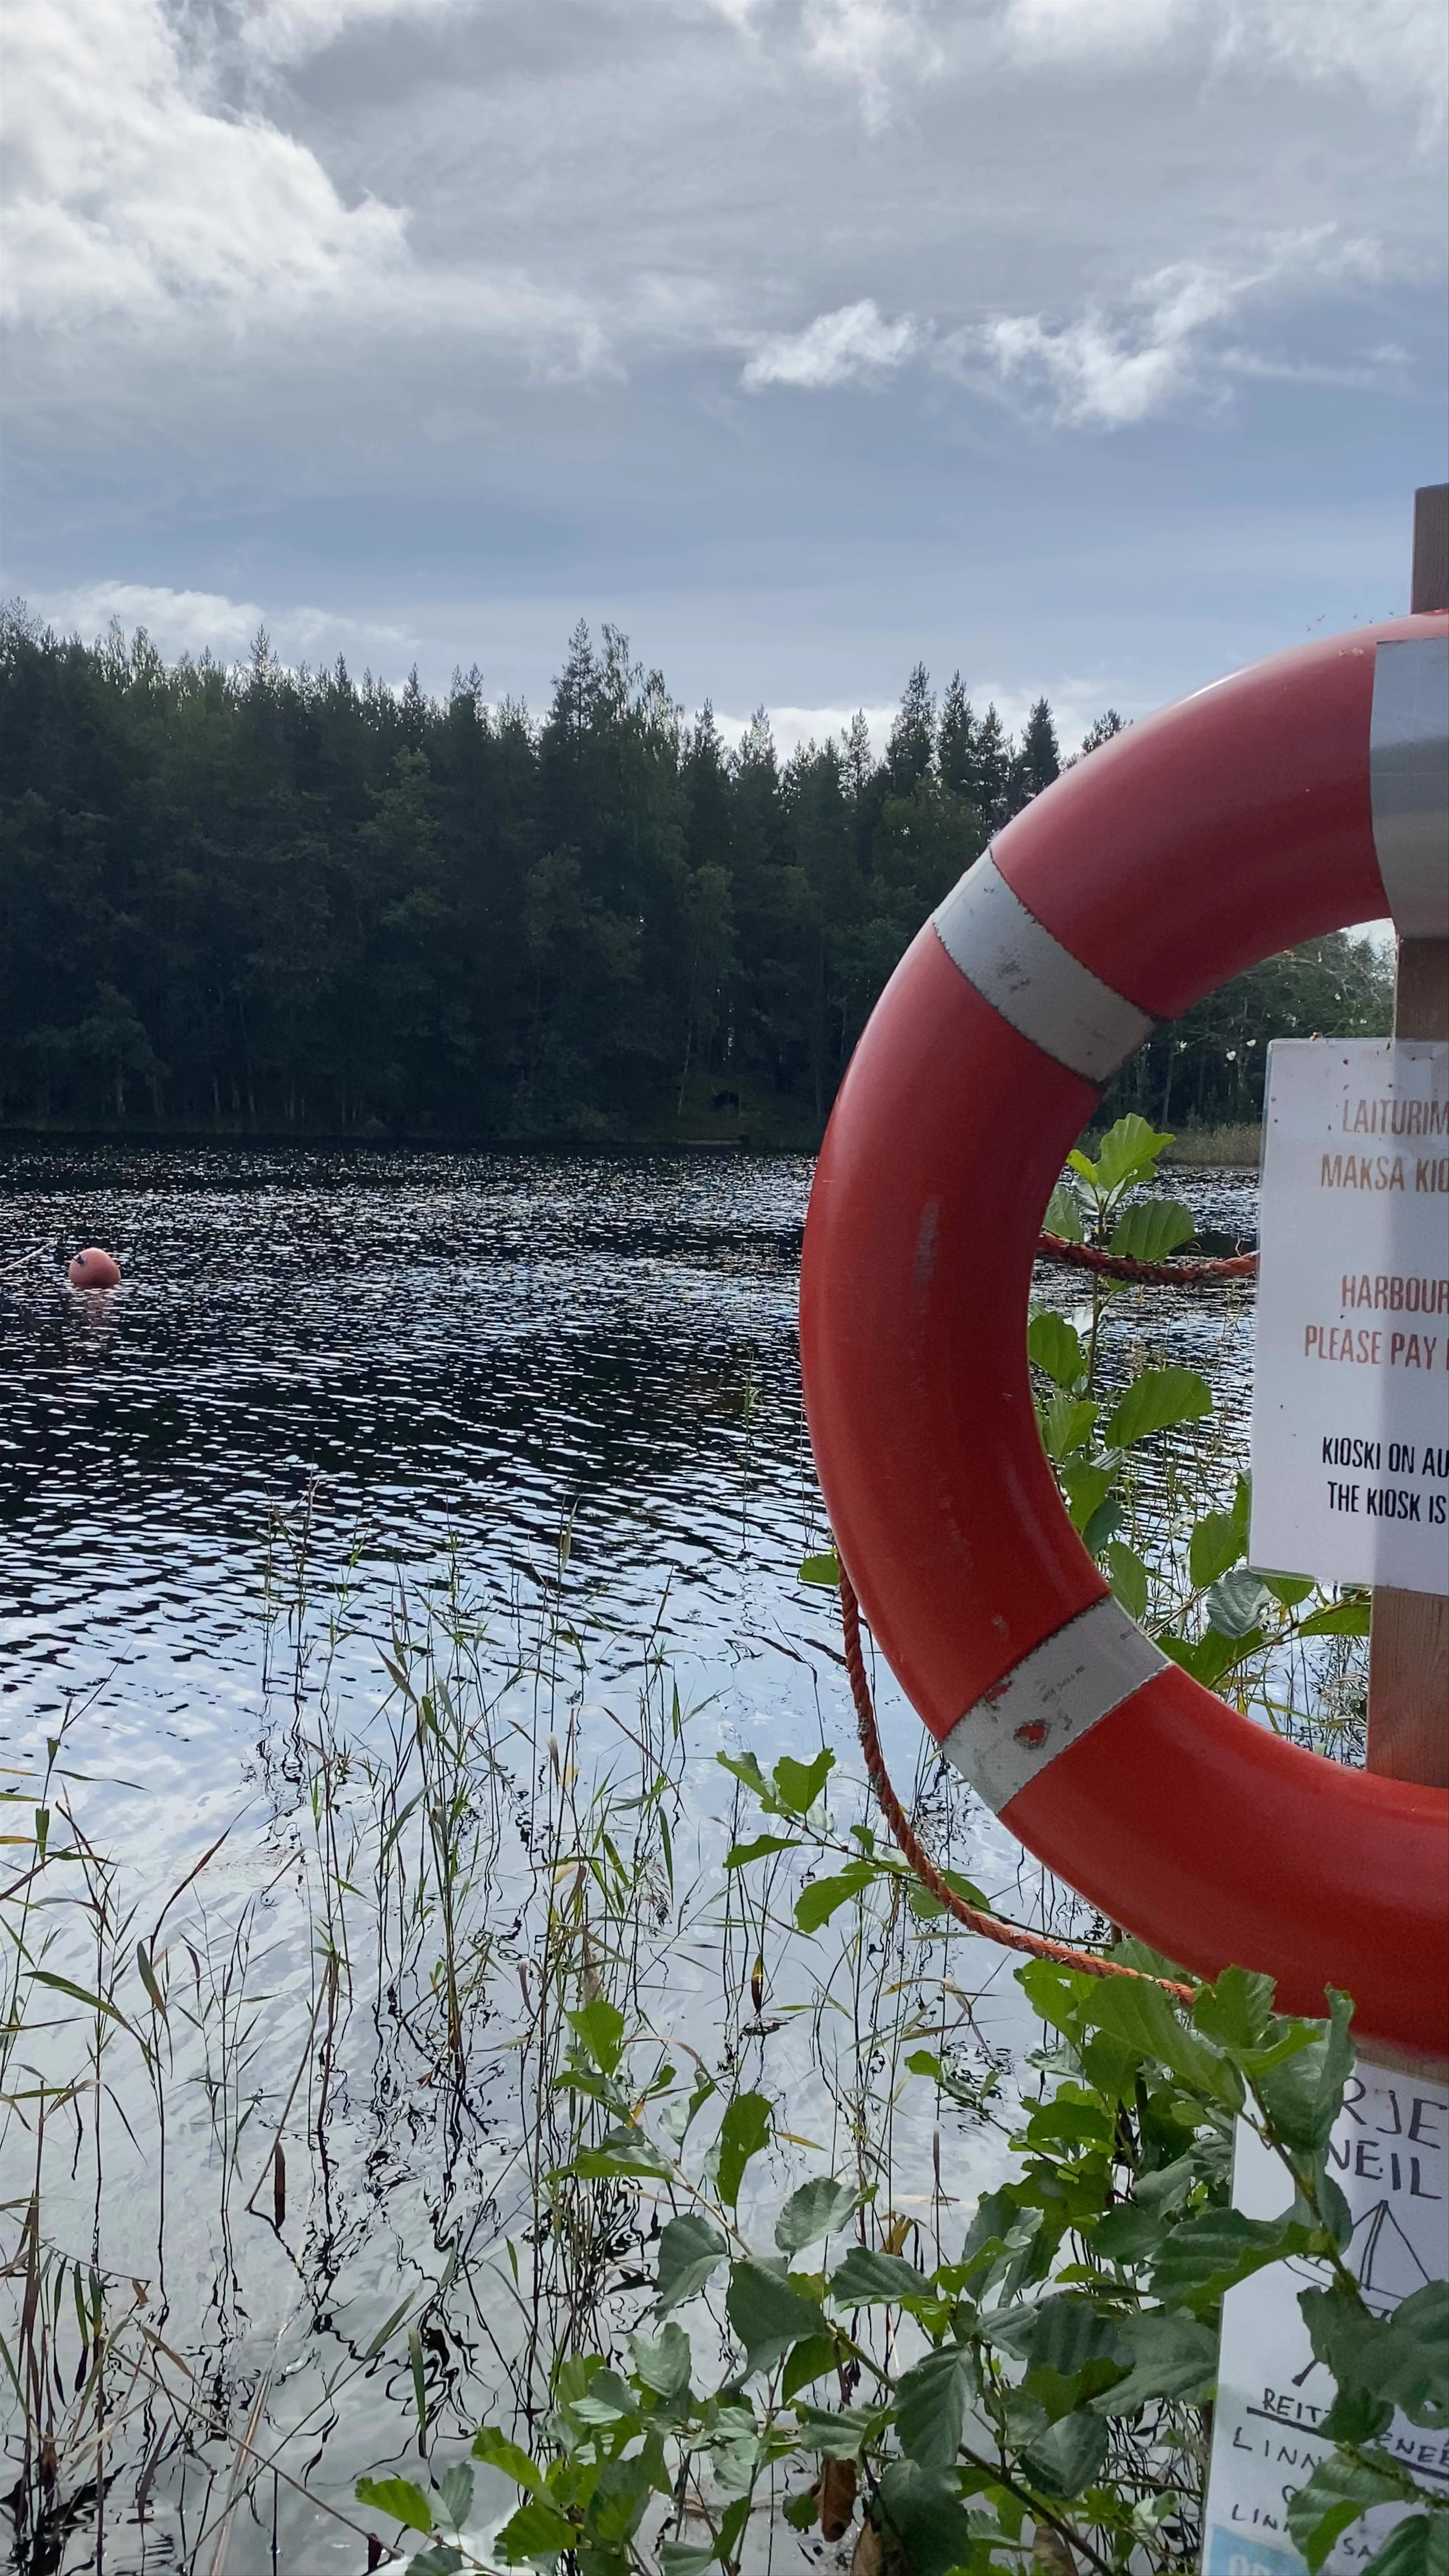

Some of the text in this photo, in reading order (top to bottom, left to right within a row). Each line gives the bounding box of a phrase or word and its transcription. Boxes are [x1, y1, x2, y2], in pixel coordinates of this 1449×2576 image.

[1321, 1153, 1405, 1192] MAKSA
[1342, 1274, 1449, 1315] HARBOUR
[1304, 1324, 1383, 1365] PLEASE
[1391, 1332, 1438, 1371] PAY
[1323, 1436, 1449, 1478] KIOSKI ON AU
[1327, 1481, 1447, 1524] THE KIOSK IS
[1263, 2388, 1332, 2423] REIT
[1232, 2426, 1322, 2469] LINN
[1232, 2504, 1290, 2532] LIN
